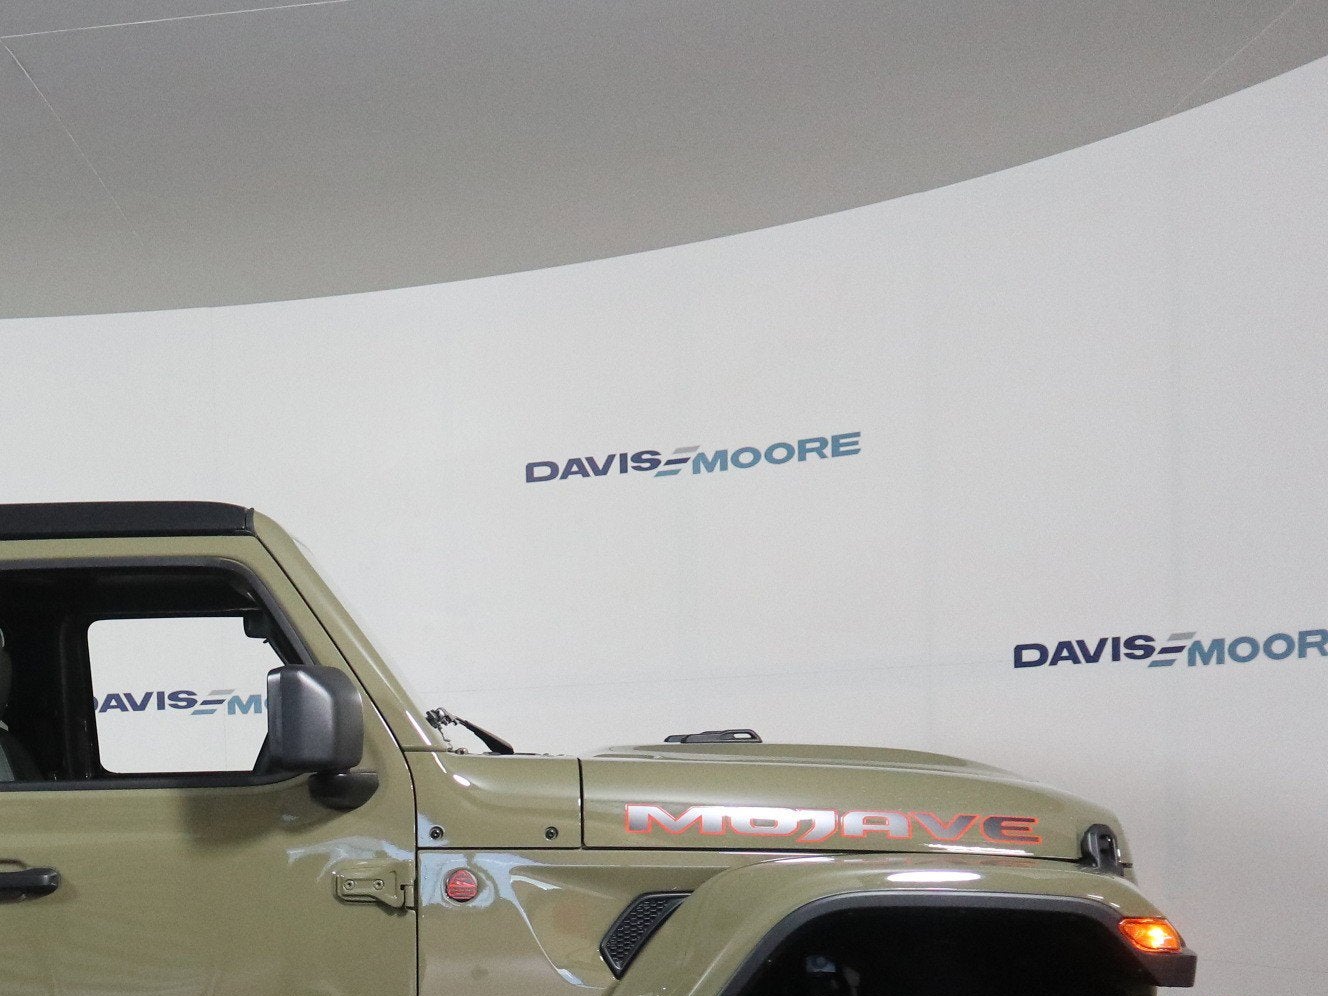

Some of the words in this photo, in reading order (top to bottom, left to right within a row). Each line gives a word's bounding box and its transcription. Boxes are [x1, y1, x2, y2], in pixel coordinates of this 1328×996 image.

[525, 450, 662, 483] DAVIS
[692, 431, 862, 475] MOORE
[1013, 635, 1156, 669] DAVIS
[93, 690, 198, 713] AVIS
[625, 803, 1043, 844] MOJAVE
